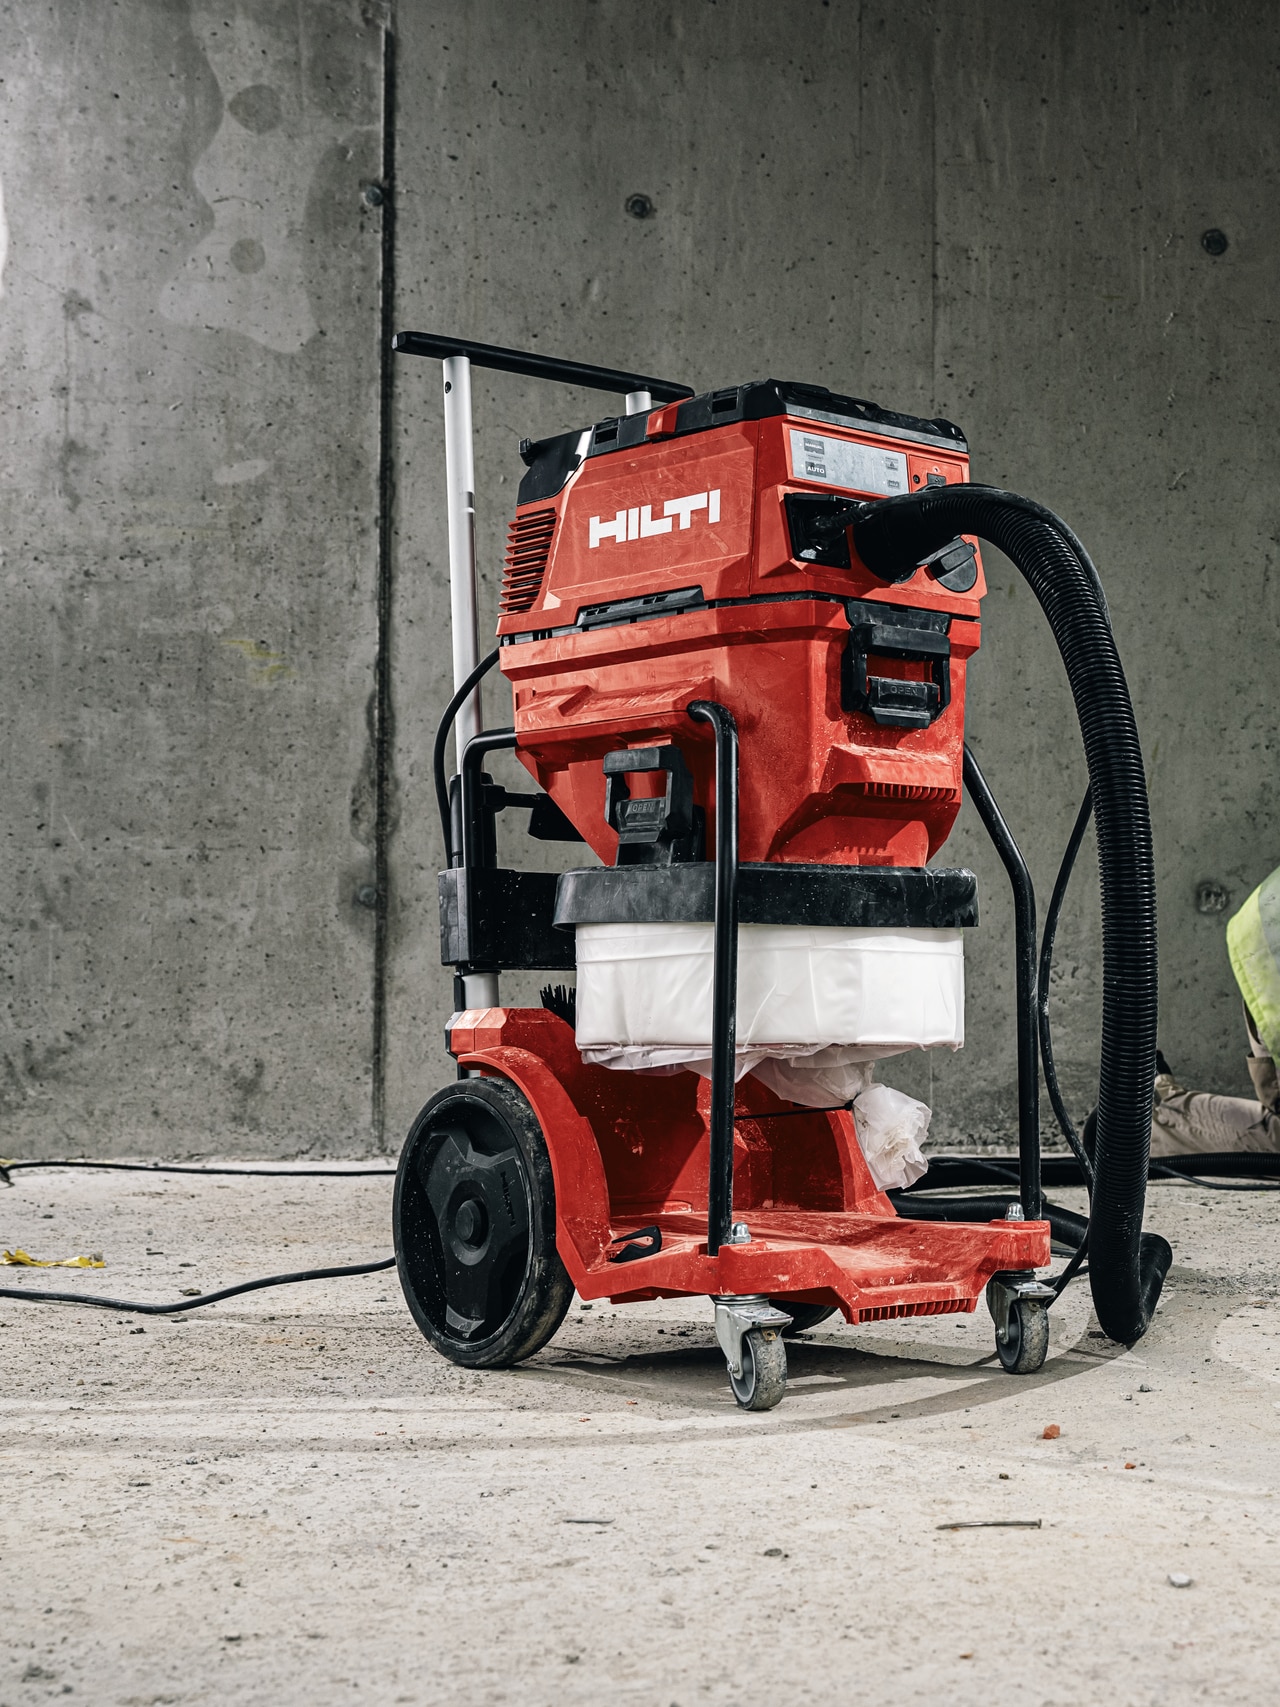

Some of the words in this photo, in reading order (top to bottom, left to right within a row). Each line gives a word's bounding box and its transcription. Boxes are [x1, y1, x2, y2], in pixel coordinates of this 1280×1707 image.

[807, 465, 825, 474] AUTO
[589, 489, 720, 549] HILTI
[890, 685, 918, 696] OPEN
[632, 801, 656, 812] OPEN
